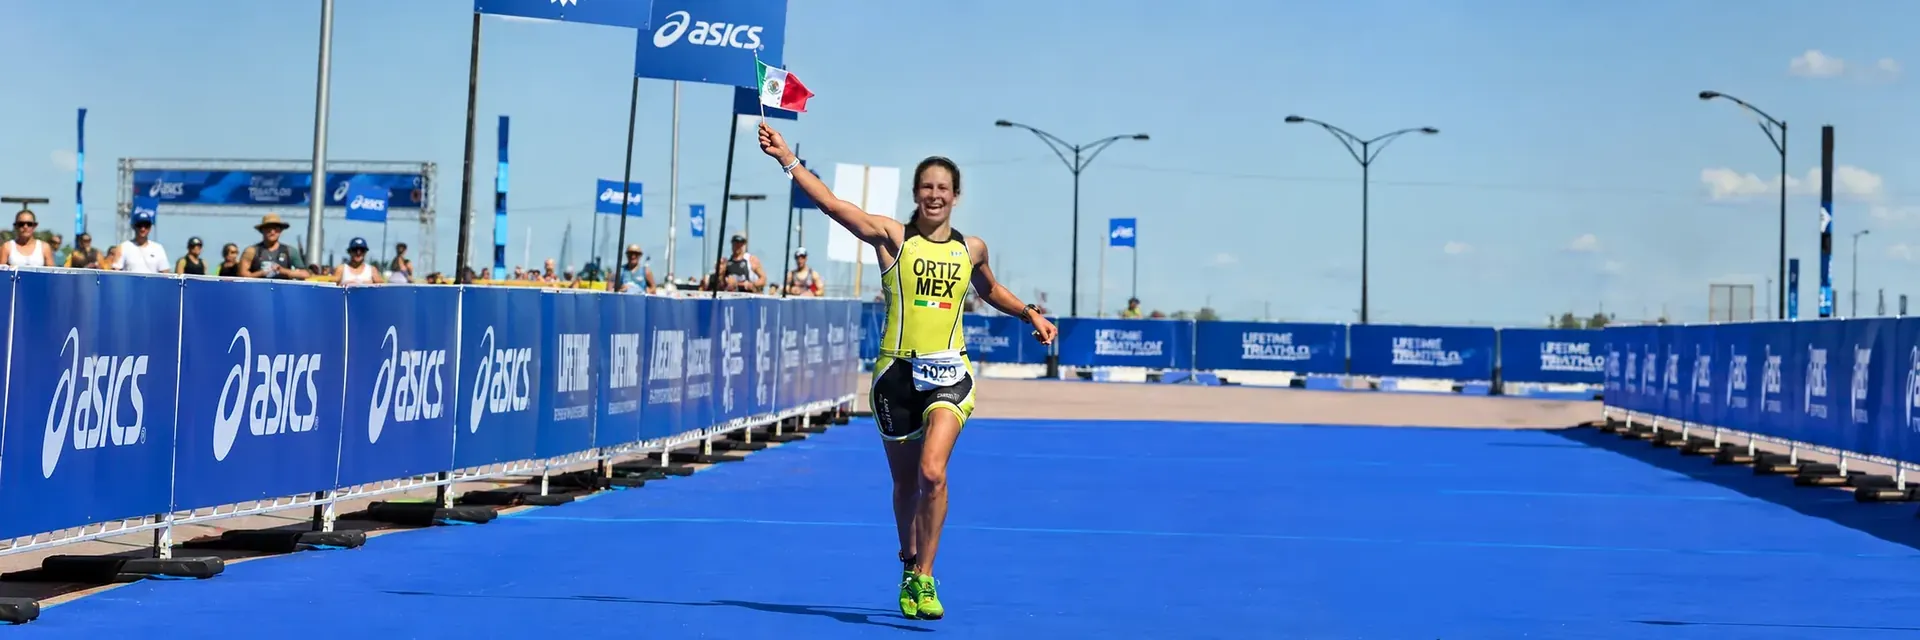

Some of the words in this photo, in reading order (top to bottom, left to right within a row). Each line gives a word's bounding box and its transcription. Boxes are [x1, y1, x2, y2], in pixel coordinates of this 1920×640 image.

[913, 258, 961, 281] ORTIZ
[916, 278, 956, 298] MEX
[1242, 331, 1293, 344] LIFETIME
[1241, 344, 1310, 356] TRIATHLO
[1540, 341, 1590, 354] LIFETIME
[1391, 349, 1460, 361] TRIATHLO
[1540, 354, 1605, 367] TRIATHLO
[920, 364, 957, 379] 1029
